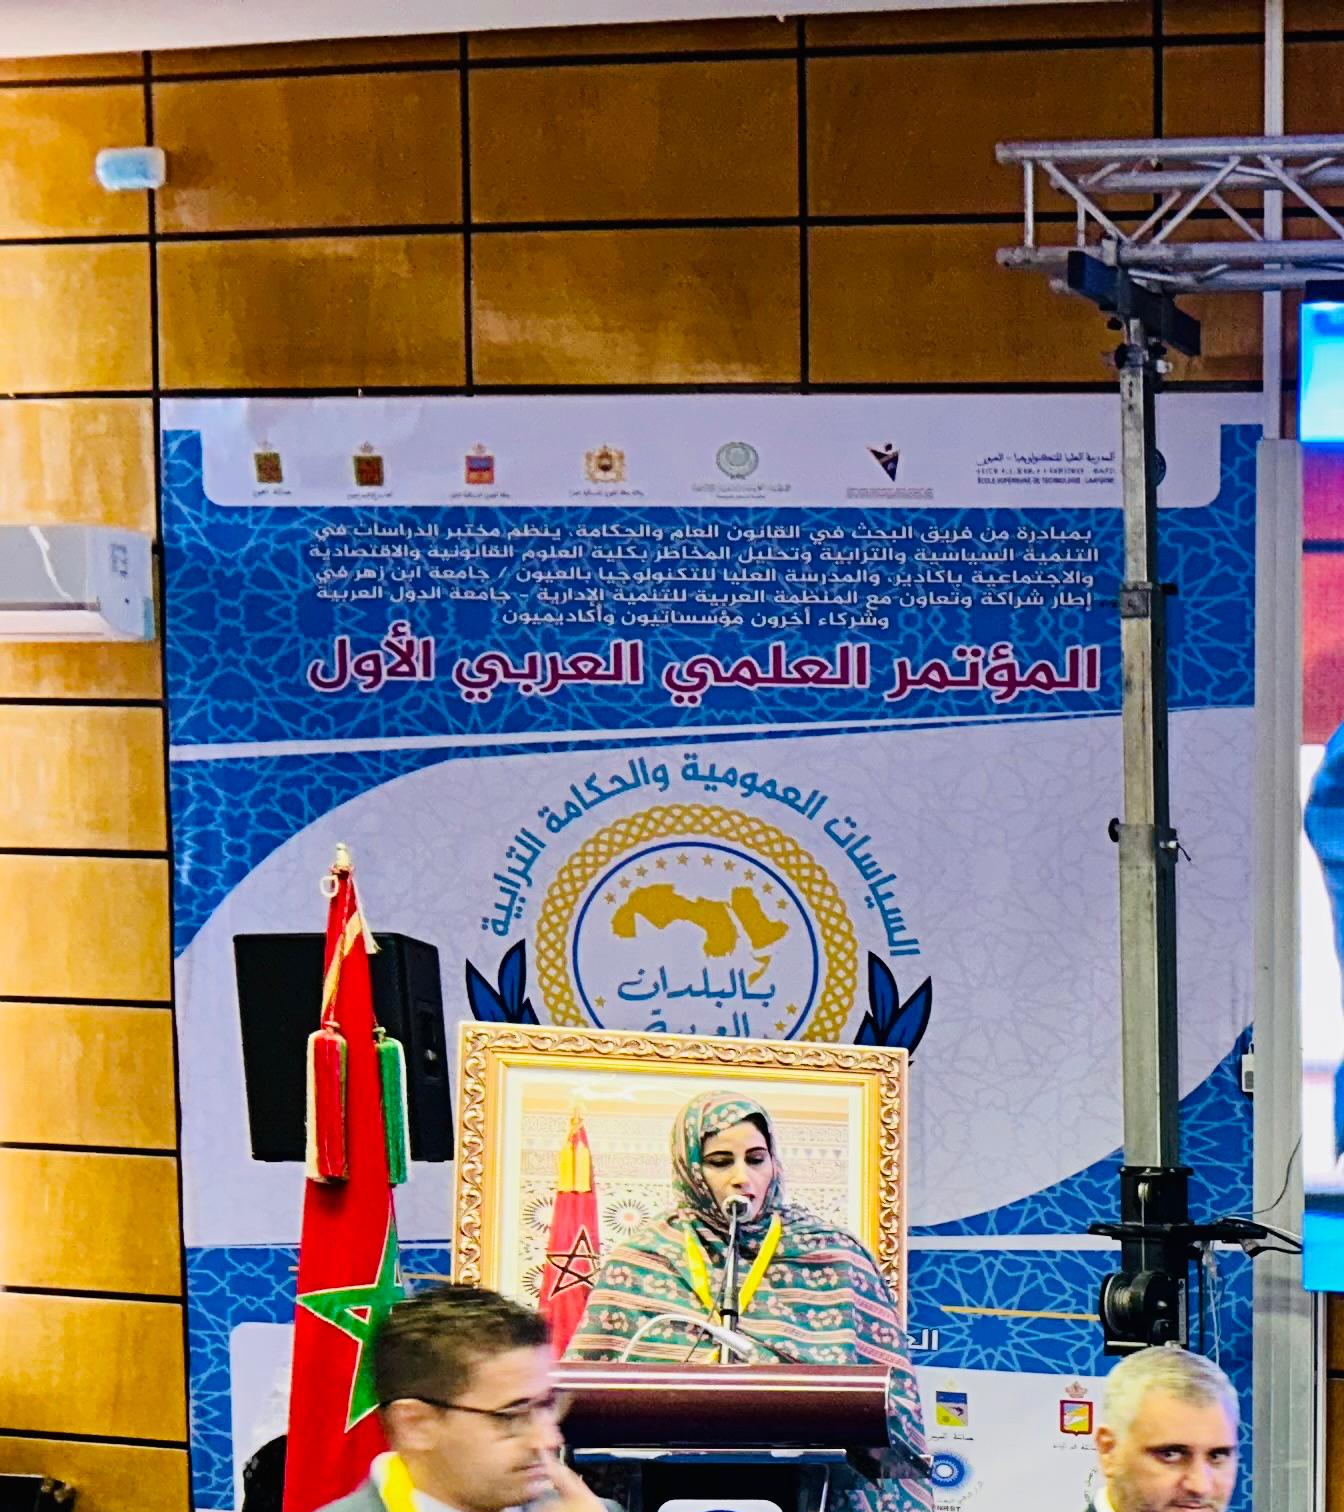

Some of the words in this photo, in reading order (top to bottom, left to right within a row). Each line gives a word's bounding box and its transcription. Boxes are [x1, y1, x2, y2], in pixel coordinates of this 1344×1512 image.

[315, 523, 347, 542] في
[353, 522, 440, 539] الدراسات
[445, 523, 500, 540] مختبر
[507, 523, 561, 541] ينظم
[670, 524, 719, 542] العام
[727, 524, 800, 542] القانون
[809, 525, 845, 545] في
[852, 523, 913, 543] البحث
[920, 525, 973, 543] فريق
[980, 527, 1010, 543] من
[1016, 526, 1092, 544] بمبادرة
[309, 543, 421, 561] والاقتصادية
[427, 544, 514, 561] القانونية
[522, 545, 583, 562] العلوم
[591, 545, 648, 562] بكلية
[654, 545, 731, 563] المخاطر
[738, 546, 813, 564] وتحليل
[819, 547, 907, 565] والترابية
[914, 548, 1015, 565] السياسية
[1023, 548, 1099, 565] التنمية
[315, 564, 349, 584] في
[354, 565, 385, 582] زهر
[391, 565, 421, 581] ابن
[428, 565, 490, 583] جامعة
[498, 566, 508, 579] /
[516, 566, 592, 583] بالعيون
[599, 566, 716, 584] للتكنولوجيا
[723, 567, 777, 585] العليا
[785, 568, 881, 586] والمدرسة
[971, 569, 1094, 588] والاجتماعية
[316, 585, 383, 602] العربية
[389, 585, 441, 602] الدول
[449, 586, 512, 604] جامعة
[536, 587, 605, 606] الإدارية
[612, 588, 687, 605] للتنمية
[695, 589, 765, 606] العربية
[774, 590, 858, 605] المنظمة
[866, 593, 892, 610] مع
[900, 591, 973, 608] وتعاون
[980, 589, 1044, 609] شراكة
[1050, 591, 1092, 612] إطار
[502, 603, 615, 627] وأكاديميون
[621, 609, 744, 627] مؤسساتيون
[818, 610, 890, 630] وشركاء
[306, 619, 436, 693] الأول
[451, 639, 645, 703] العربي
[663, 641, 872, 707] العلمي
[885, 640, 1101, 705] المؤتمر
[680, 752, 830, 821] العمومية
[544, 757, 671, 835] والحكامة
[480, 828, 547, 938] الترابية
[824, 815, 921, 958] السياسات
[617, 965, 777, 1008] بالبلدان
